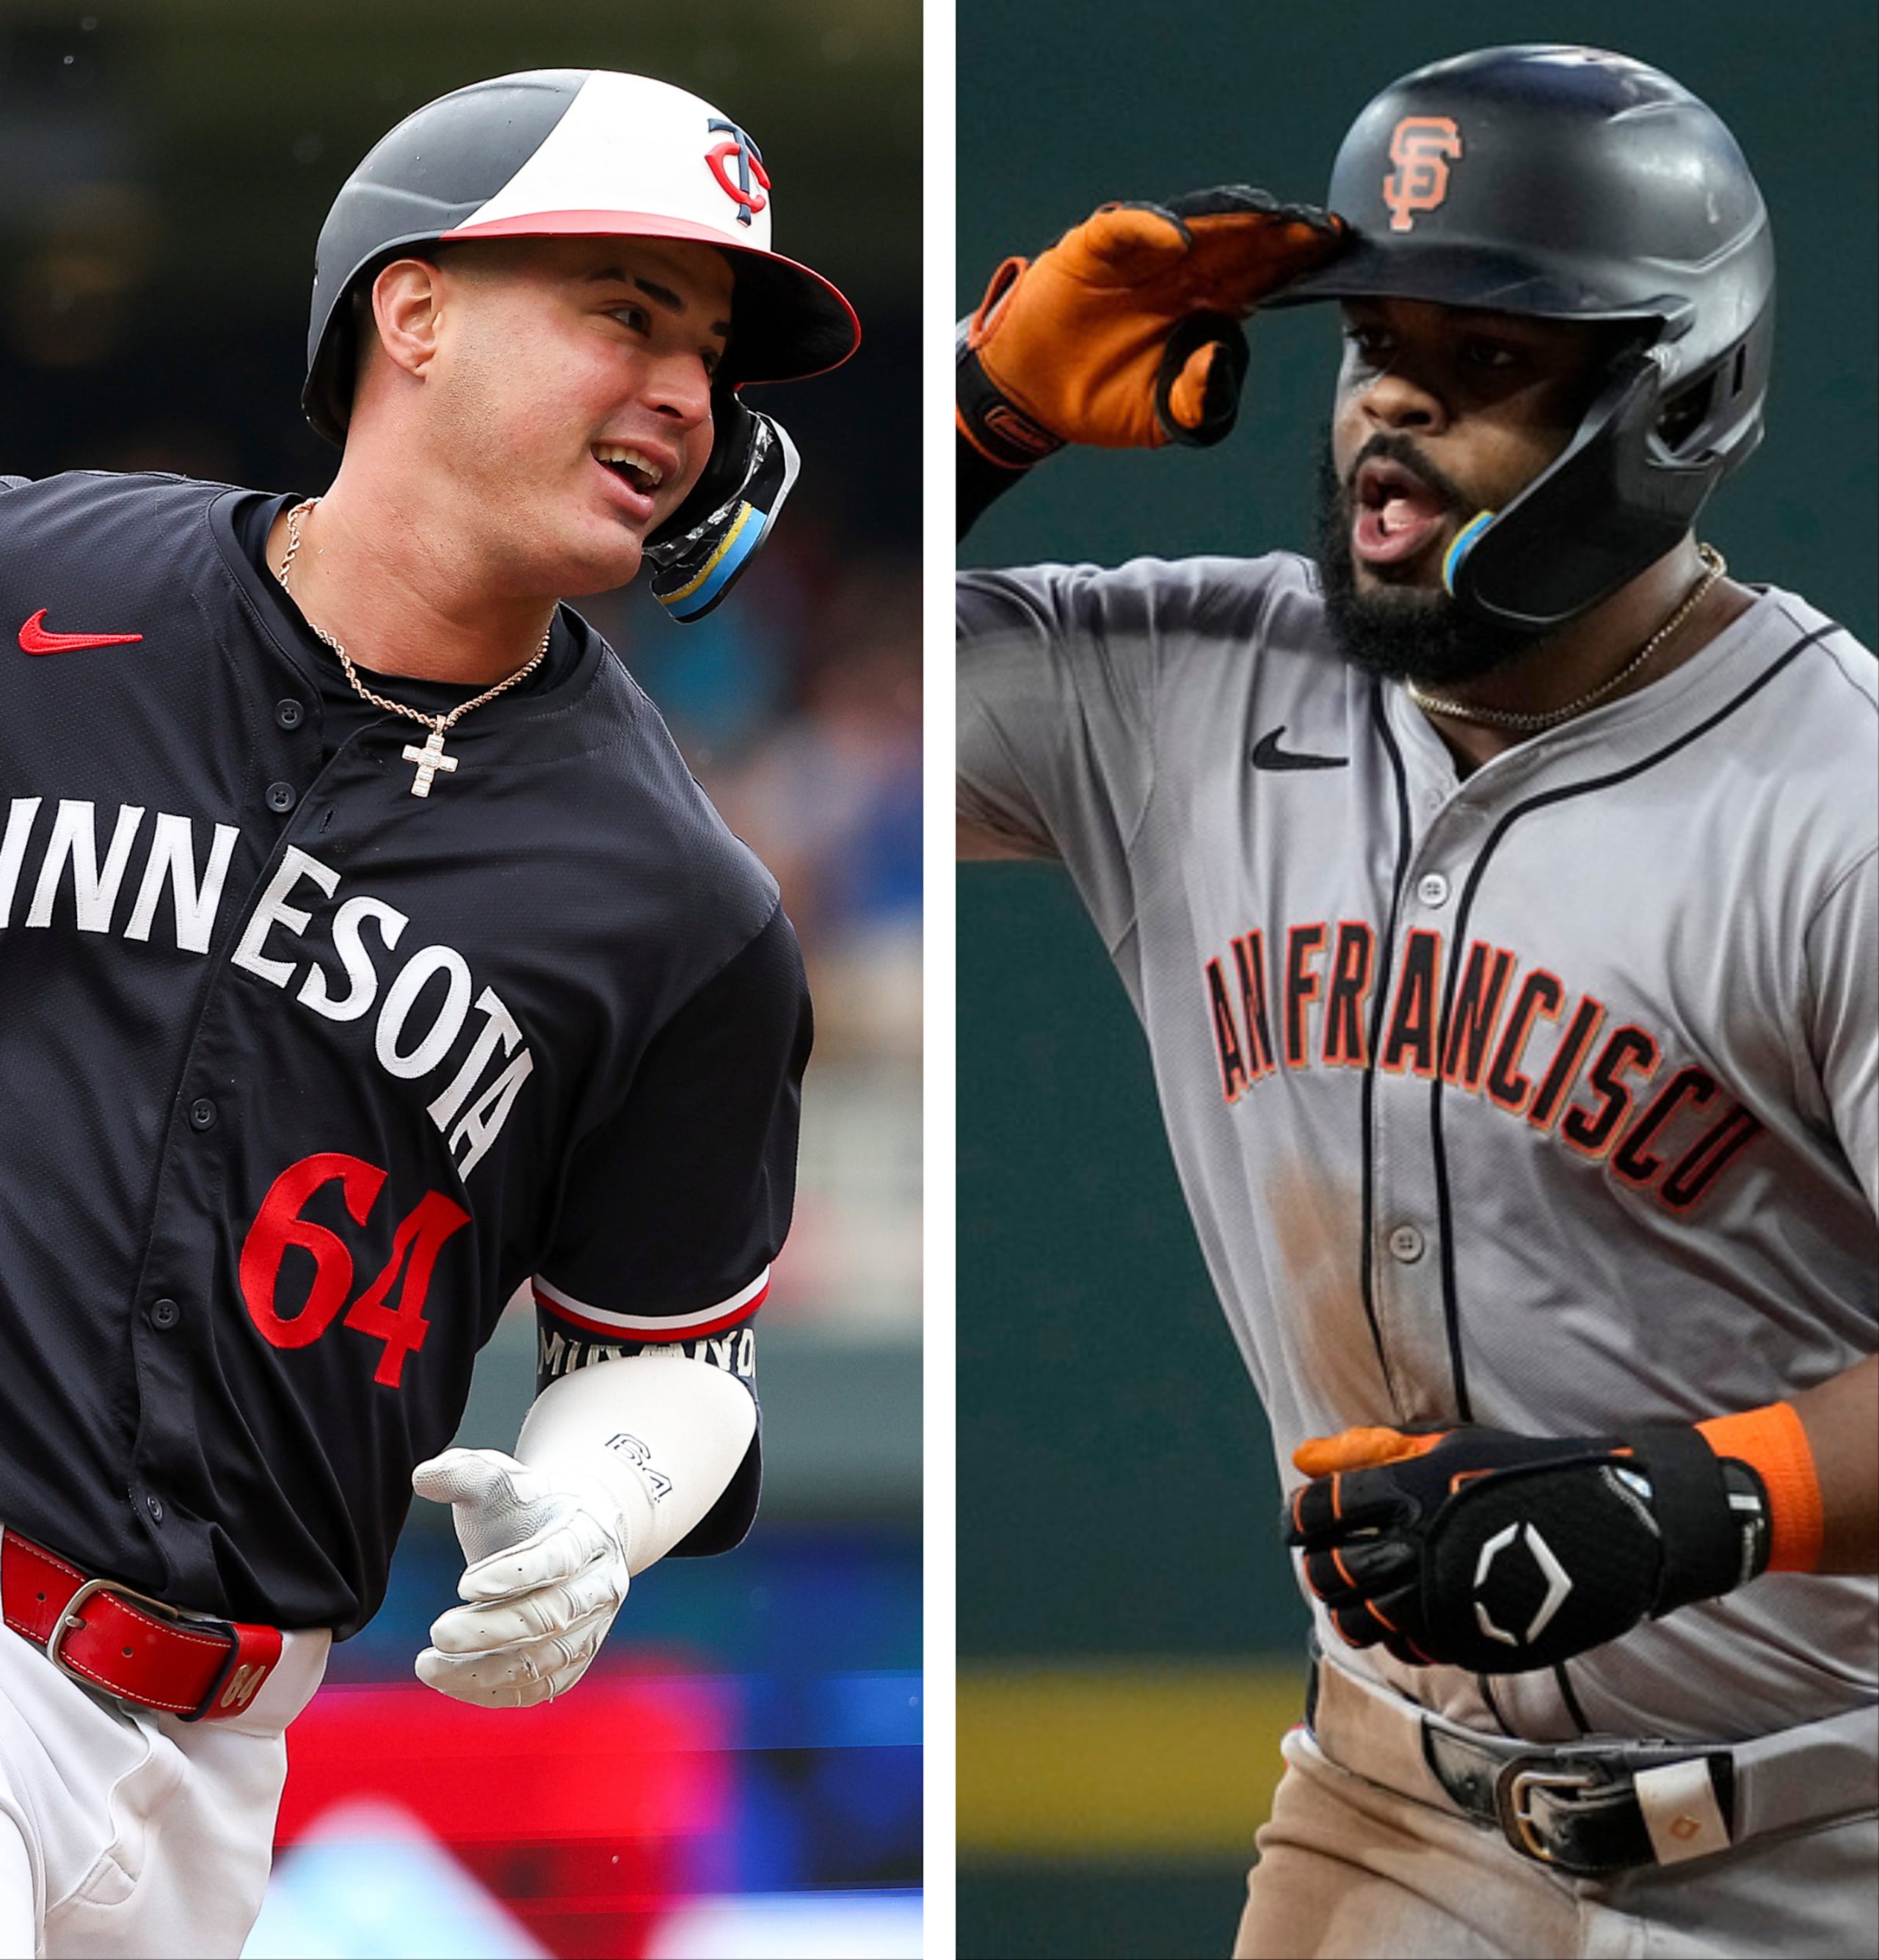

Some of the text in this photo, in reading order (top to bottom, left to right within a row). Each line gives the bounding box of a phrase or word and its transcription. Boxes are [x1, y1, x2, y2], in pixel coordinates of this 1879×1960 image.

[1383, 116, 1462, 232] SF
[1284, 921, 1764, 1215] FRANCISCO
[239, 1153, 472, 1388] 64
